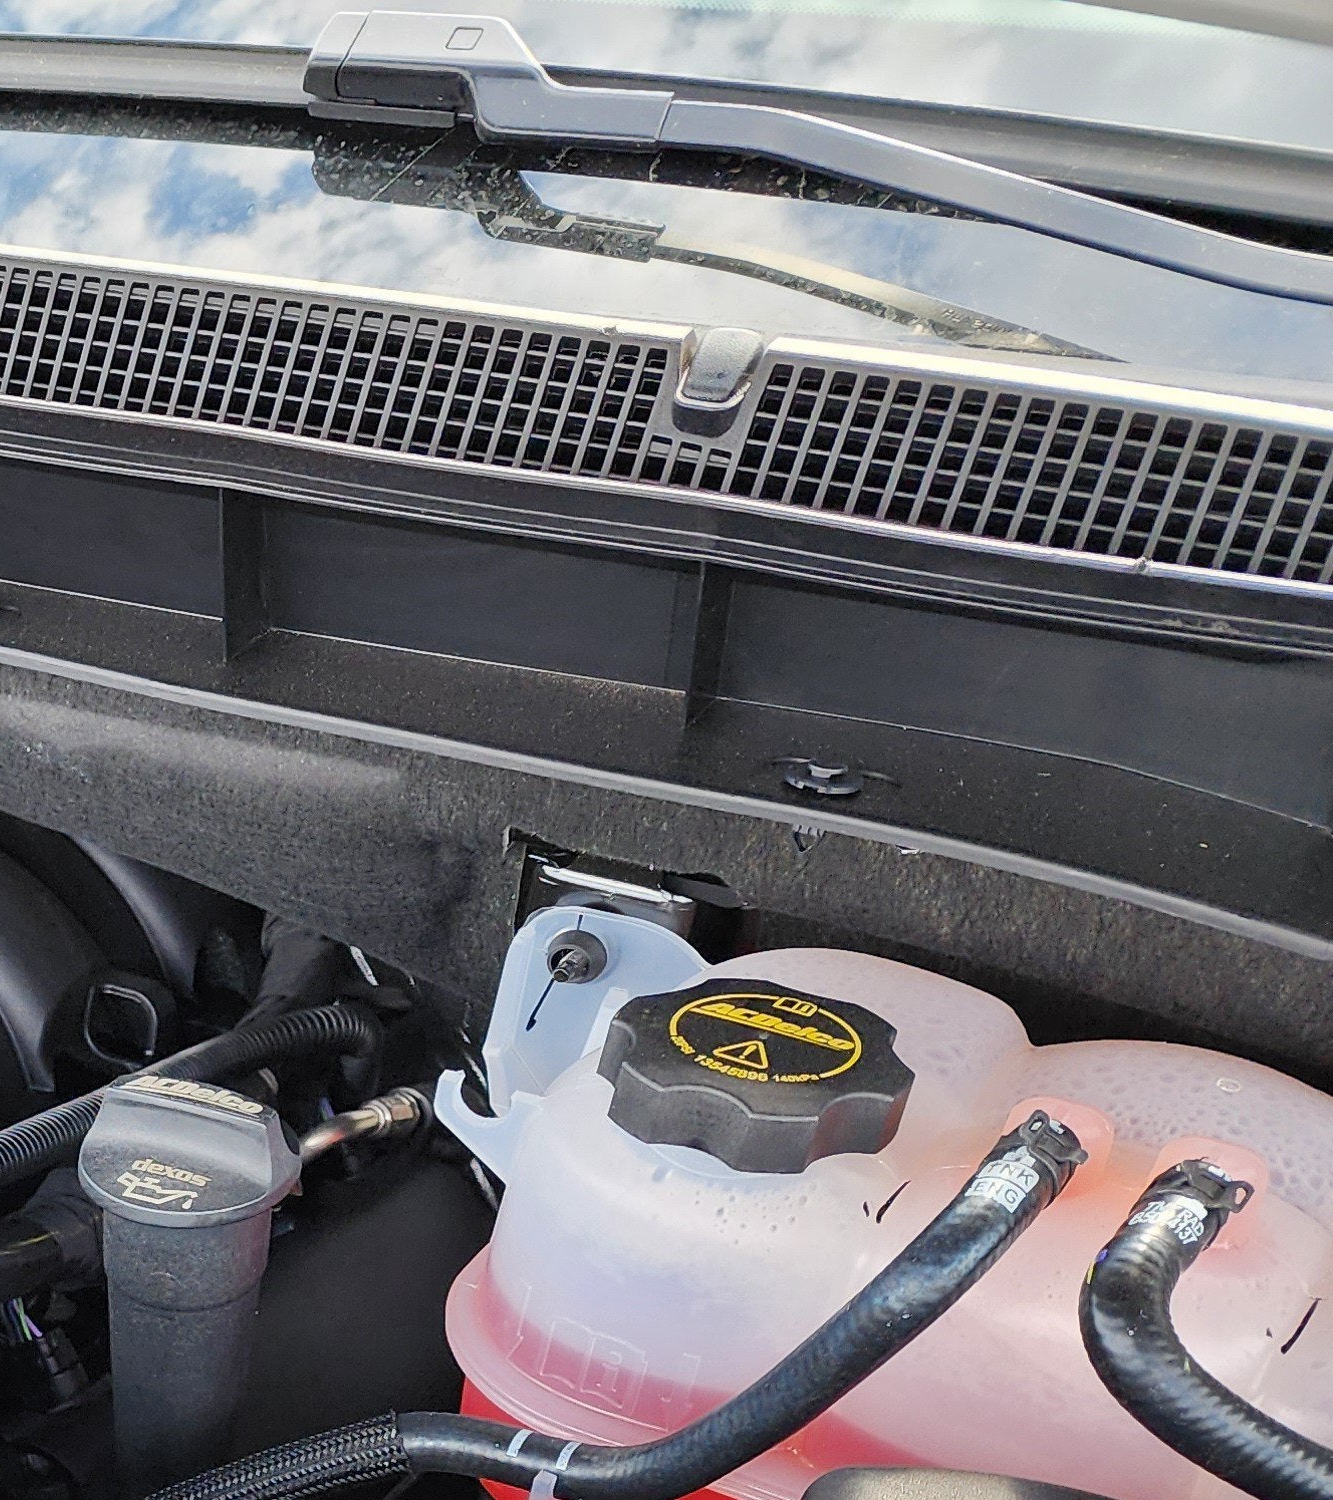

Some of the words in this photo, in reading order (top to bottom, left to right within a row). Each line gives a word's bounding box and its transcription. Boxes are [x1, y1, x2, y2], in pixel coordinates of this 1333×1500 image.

[700, 1002, 855, 1052] ACDelco
[123, 1075, 264, 1114] ACDelco
[131, 1158, 212, 1188] dexos
[985, 1161, 1035, 1187] TNK
[973, 1180, 1019, 1204] ENG
[1178, 1208, 1205, 1237] RAD
